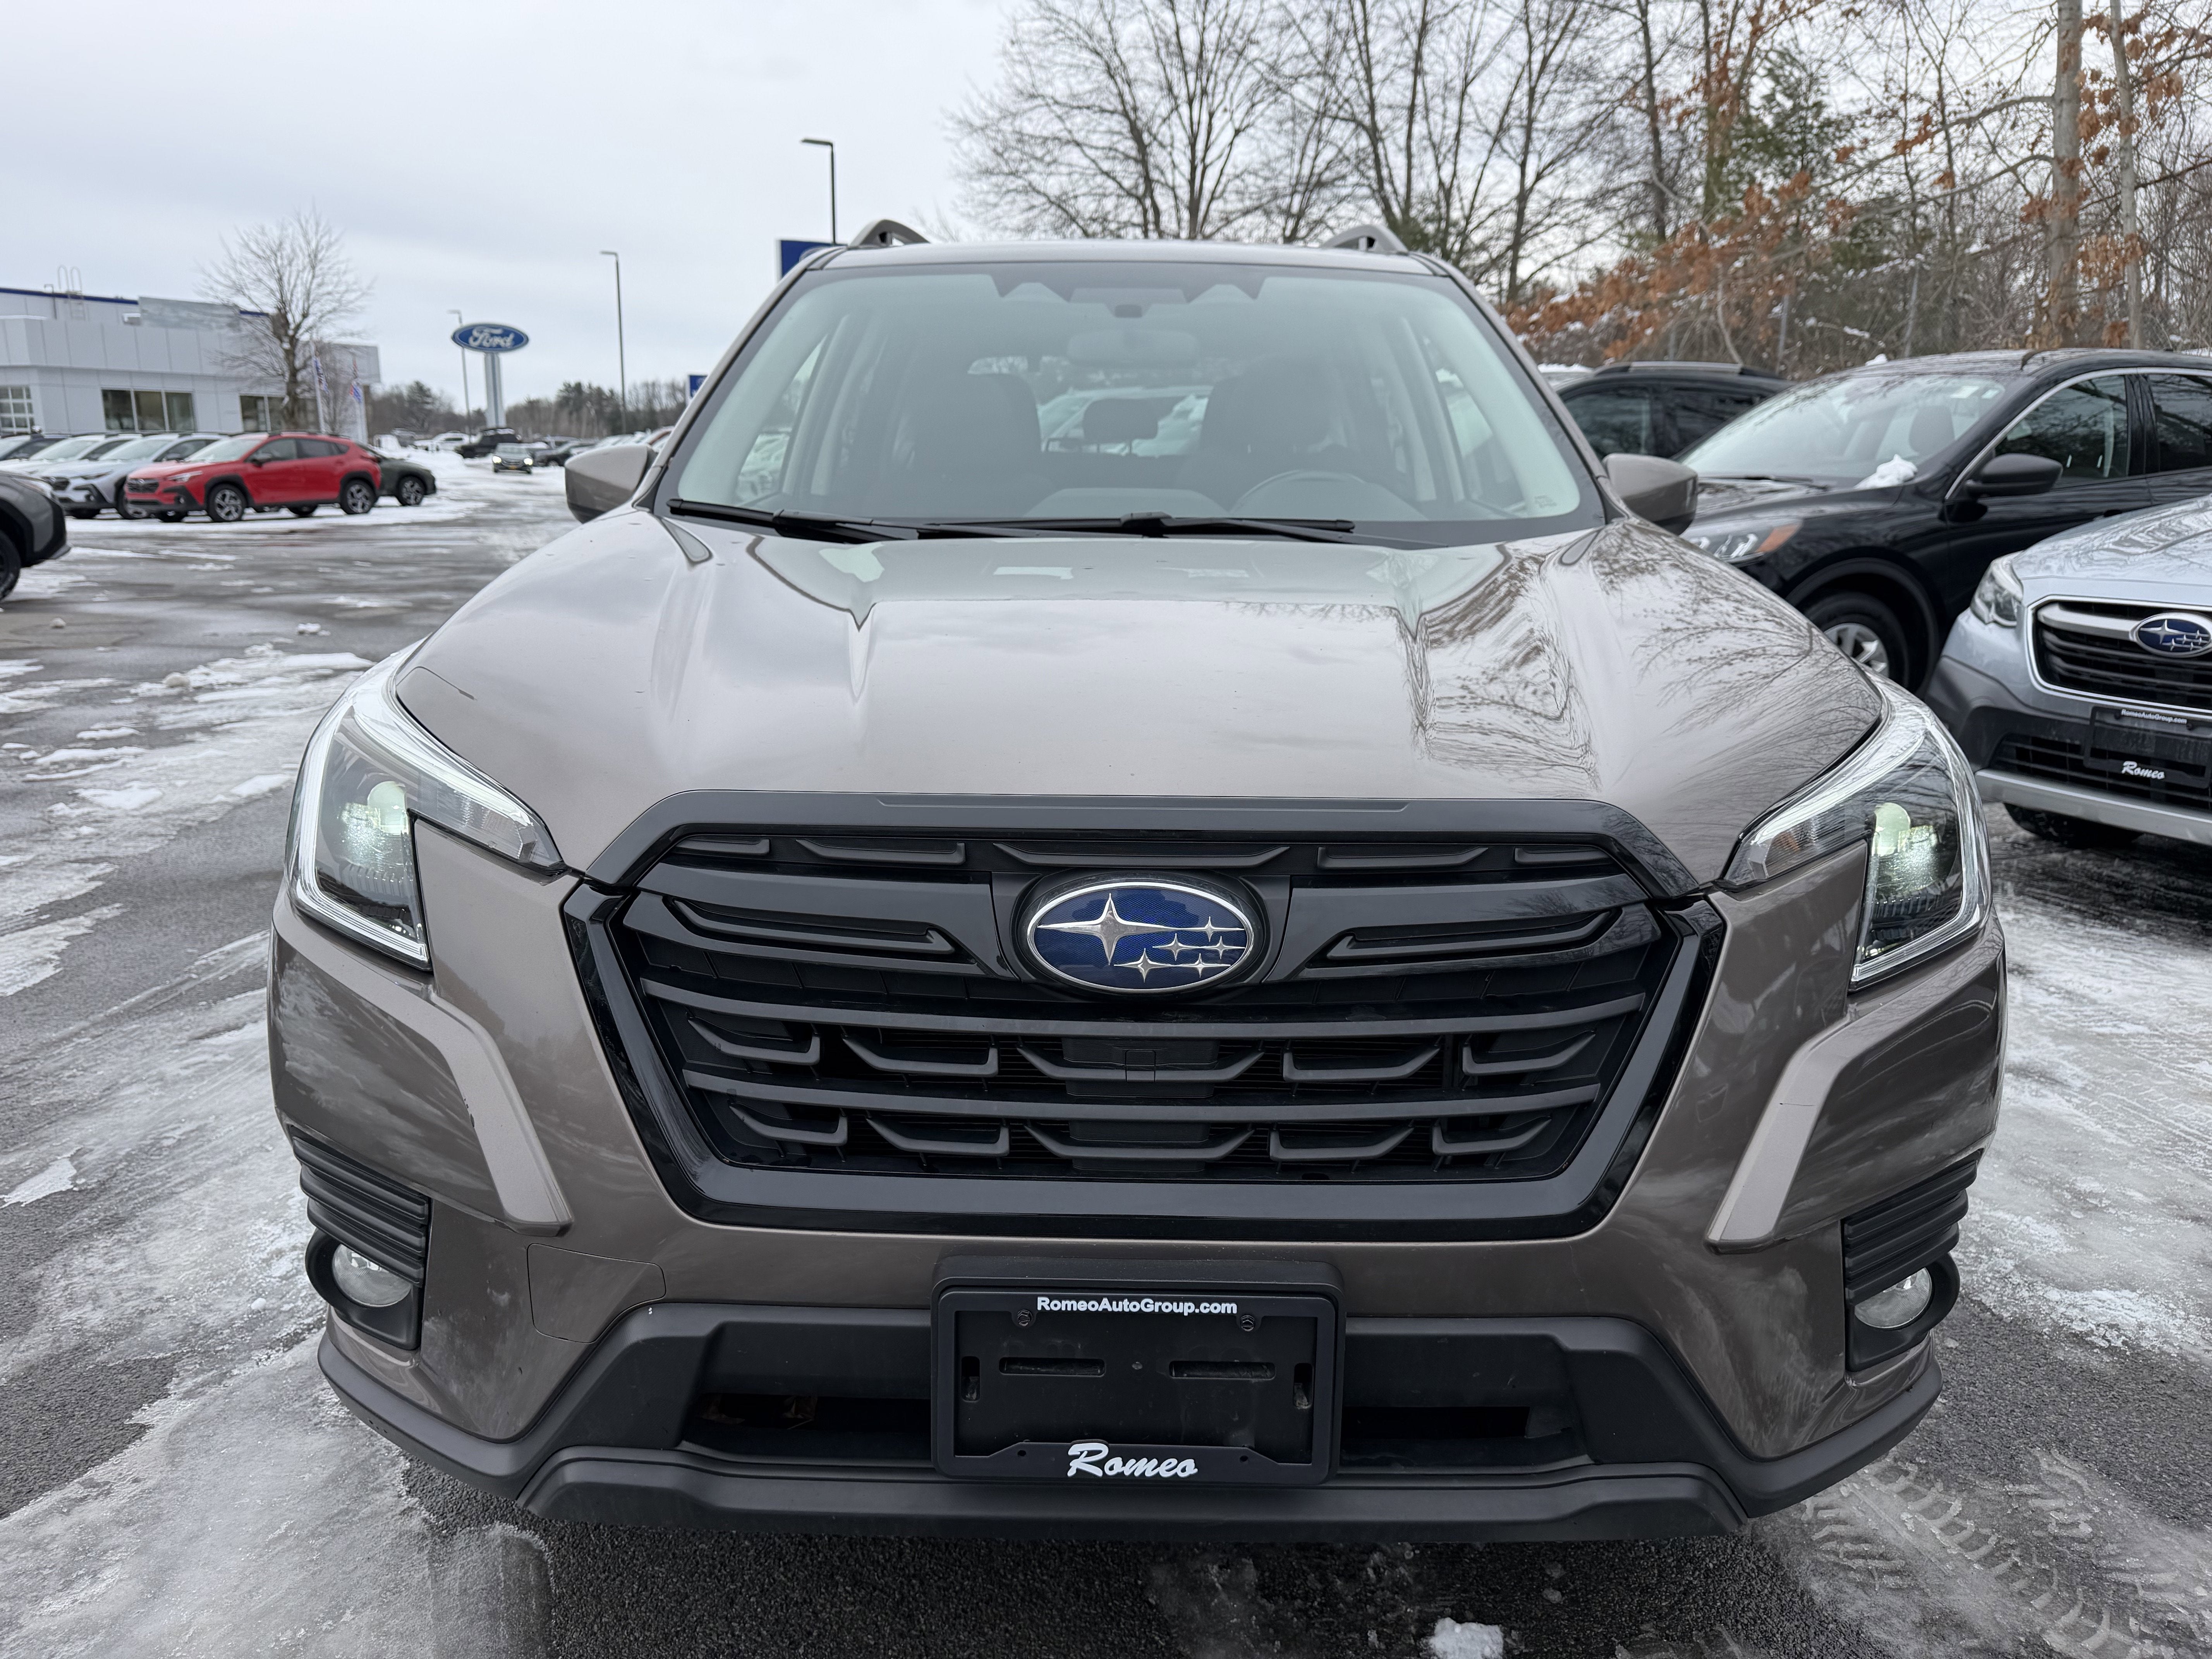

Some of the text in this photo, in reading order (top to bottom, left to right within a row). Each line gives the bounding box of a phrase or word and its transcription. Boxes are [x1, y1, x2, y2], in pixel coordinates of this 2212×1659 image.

[468, 327, 515, 347] Ford
[2121, 709, 2187, 724] RomeoAutoGroup.com
[2122, 761, 2165, 779] Romeo
[1037, 1297, 1237, 1316] RomeoAutoGroup.com
[1067, 1443, 1198, 1477] Romeo
